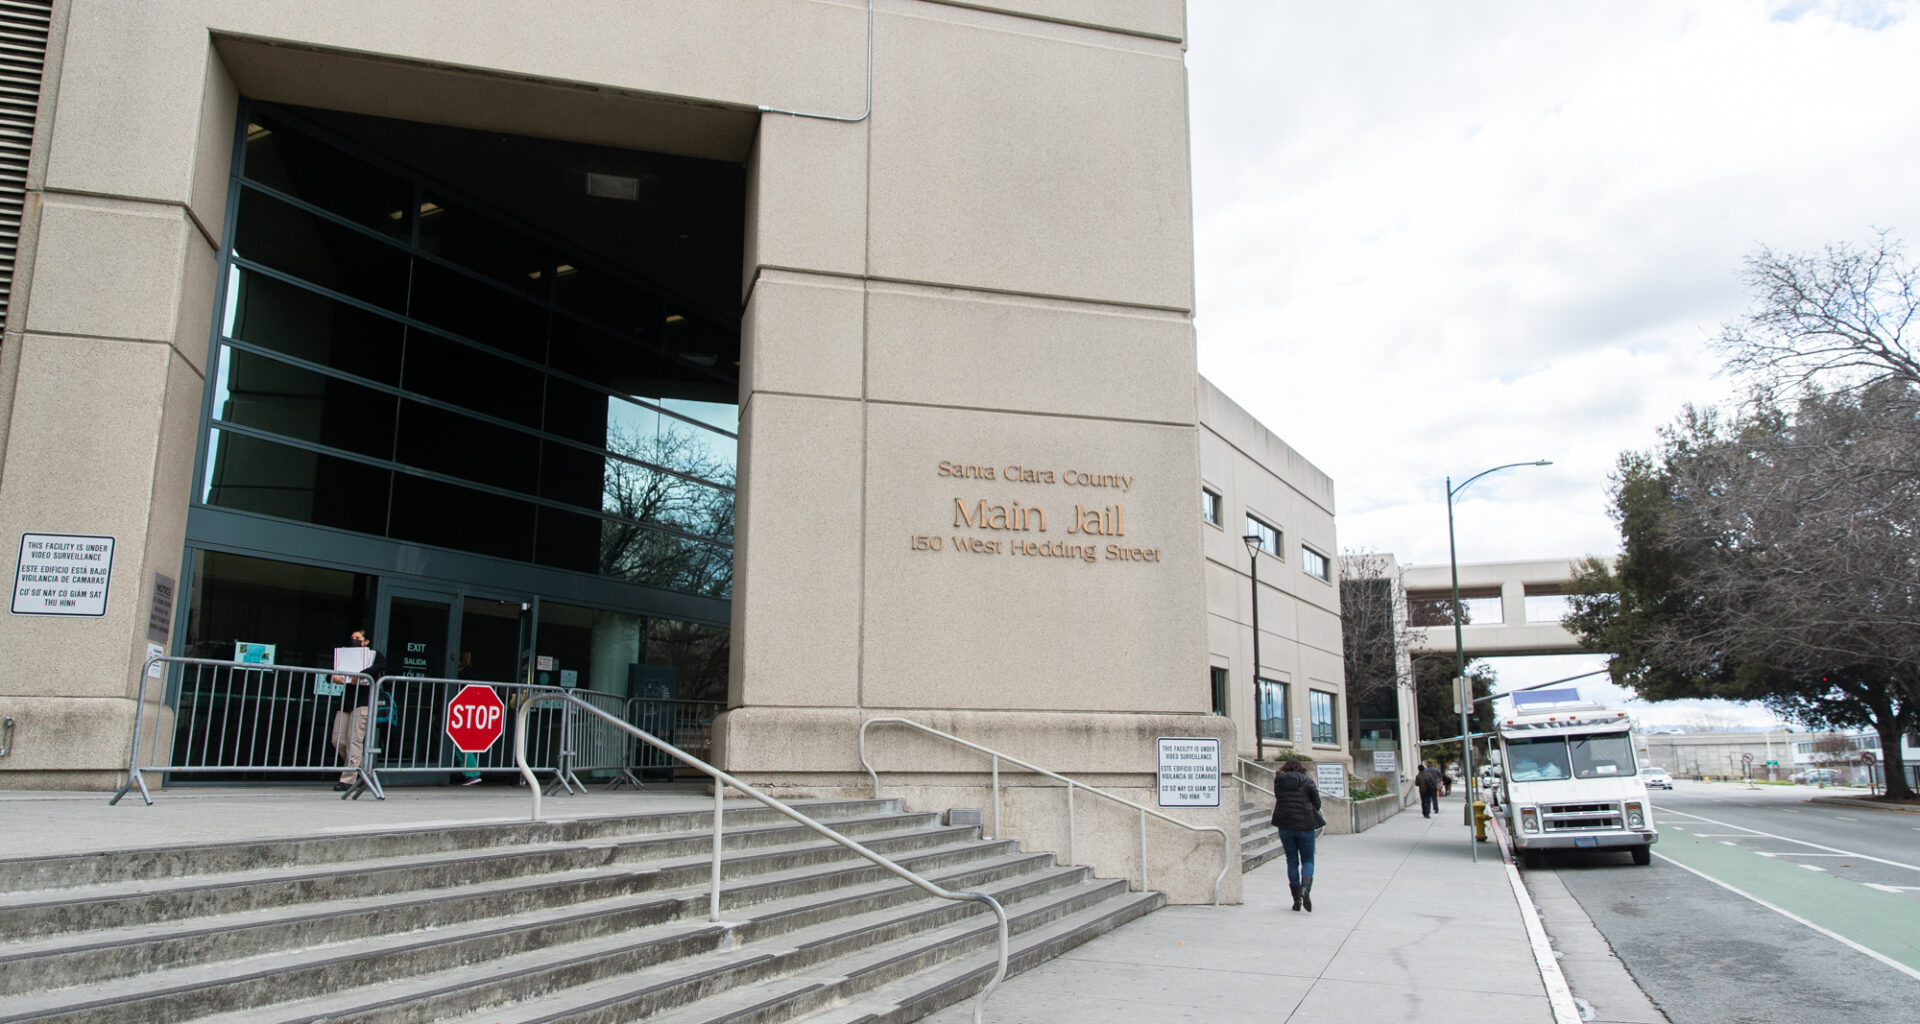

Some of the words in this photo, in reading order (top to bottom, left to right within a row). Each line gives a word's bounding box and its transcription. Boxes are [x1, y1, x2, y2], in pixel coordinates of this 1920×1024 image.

[938, 460, 997, 480] Santa
[1003, 464, 1056, 484] Clara
[1063, 468, 1134, 493] County
[953, 497, 1047, 532] Main
[1067, 502, 1125, 537] Jail
[28, 541, 43, 549] THIS
[45, 542, 75, 551] FACILITY
[76, 543, 84, 551] IS
[86, 544, 109, 552] UNDER
[911, 534, 944, 551] 150
[952, 535, 1003, 554] West
[1011, 539, 1097, 563] Hedding
[1105, 543, 1161, 562] Street
[31, 551, 51, 559] VIDEO
[53, 552, 102, 561] SURVEILLANCE
[21, 565, 39, 573] ESTE
[40, 565, 69, 574] EDIFICIO
[89, 567, 107, 575] BAJO
[21, 574, 59, 583] VIGILANCIA
[60, 575, 70, 583] DE
[72, 576, 105, 584] CAMARAS
[44, 598, 58, 607] THU
[407, 642, 427, 653] EXIT
[403, 656, 427, 665] SALIDA
[451, 704, 500, 730] STOP
